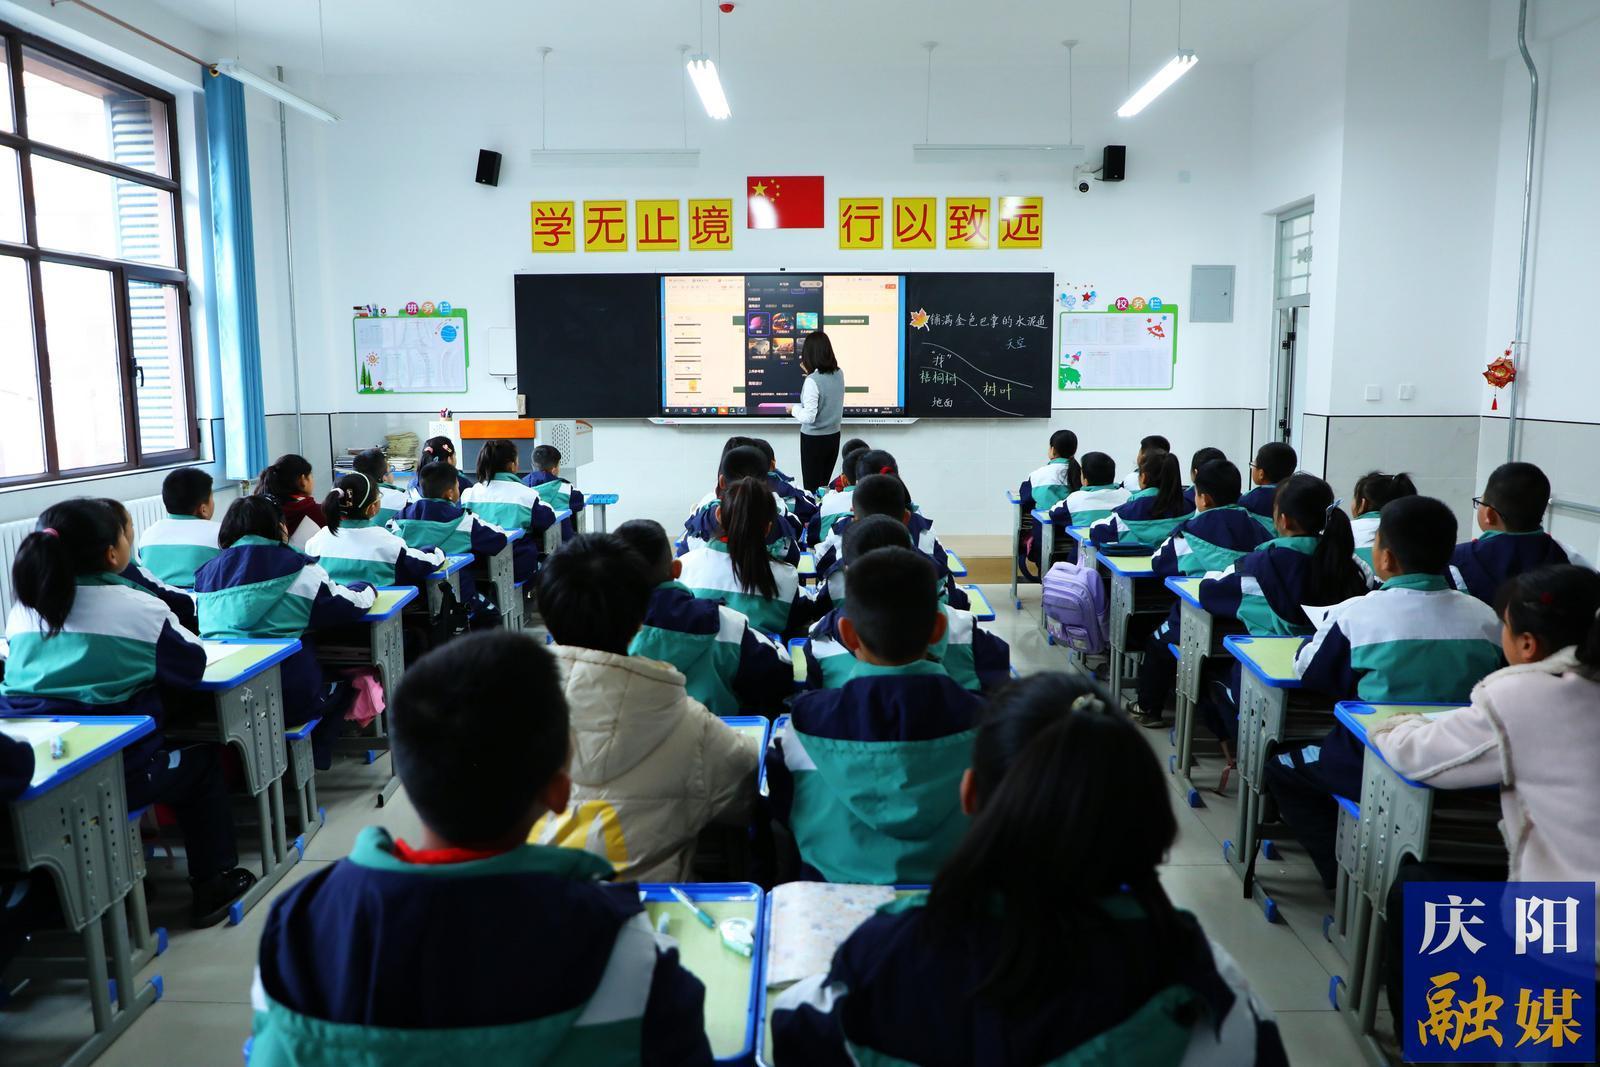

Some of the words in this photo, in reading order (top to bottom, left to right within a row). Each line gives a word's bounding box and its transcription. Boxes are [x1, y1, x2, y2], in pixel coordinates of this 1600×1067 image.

[534, 205, 730, 246] 学无止境
[842, 204, 1040, 243] 行以致远
[406, 302, 451, 314] 班务栏
[1115, 298, 1162, 310] 校务栏
[929, 312, 1048, 329] 铺满金色巴掌的水泥道
[1006, 336, 1026, 350] 天空
[919, 370, 958, 386] 梧桐树
[983, 381, 1012, 400] 树叶
[931, 396, 953, 408] 地面
